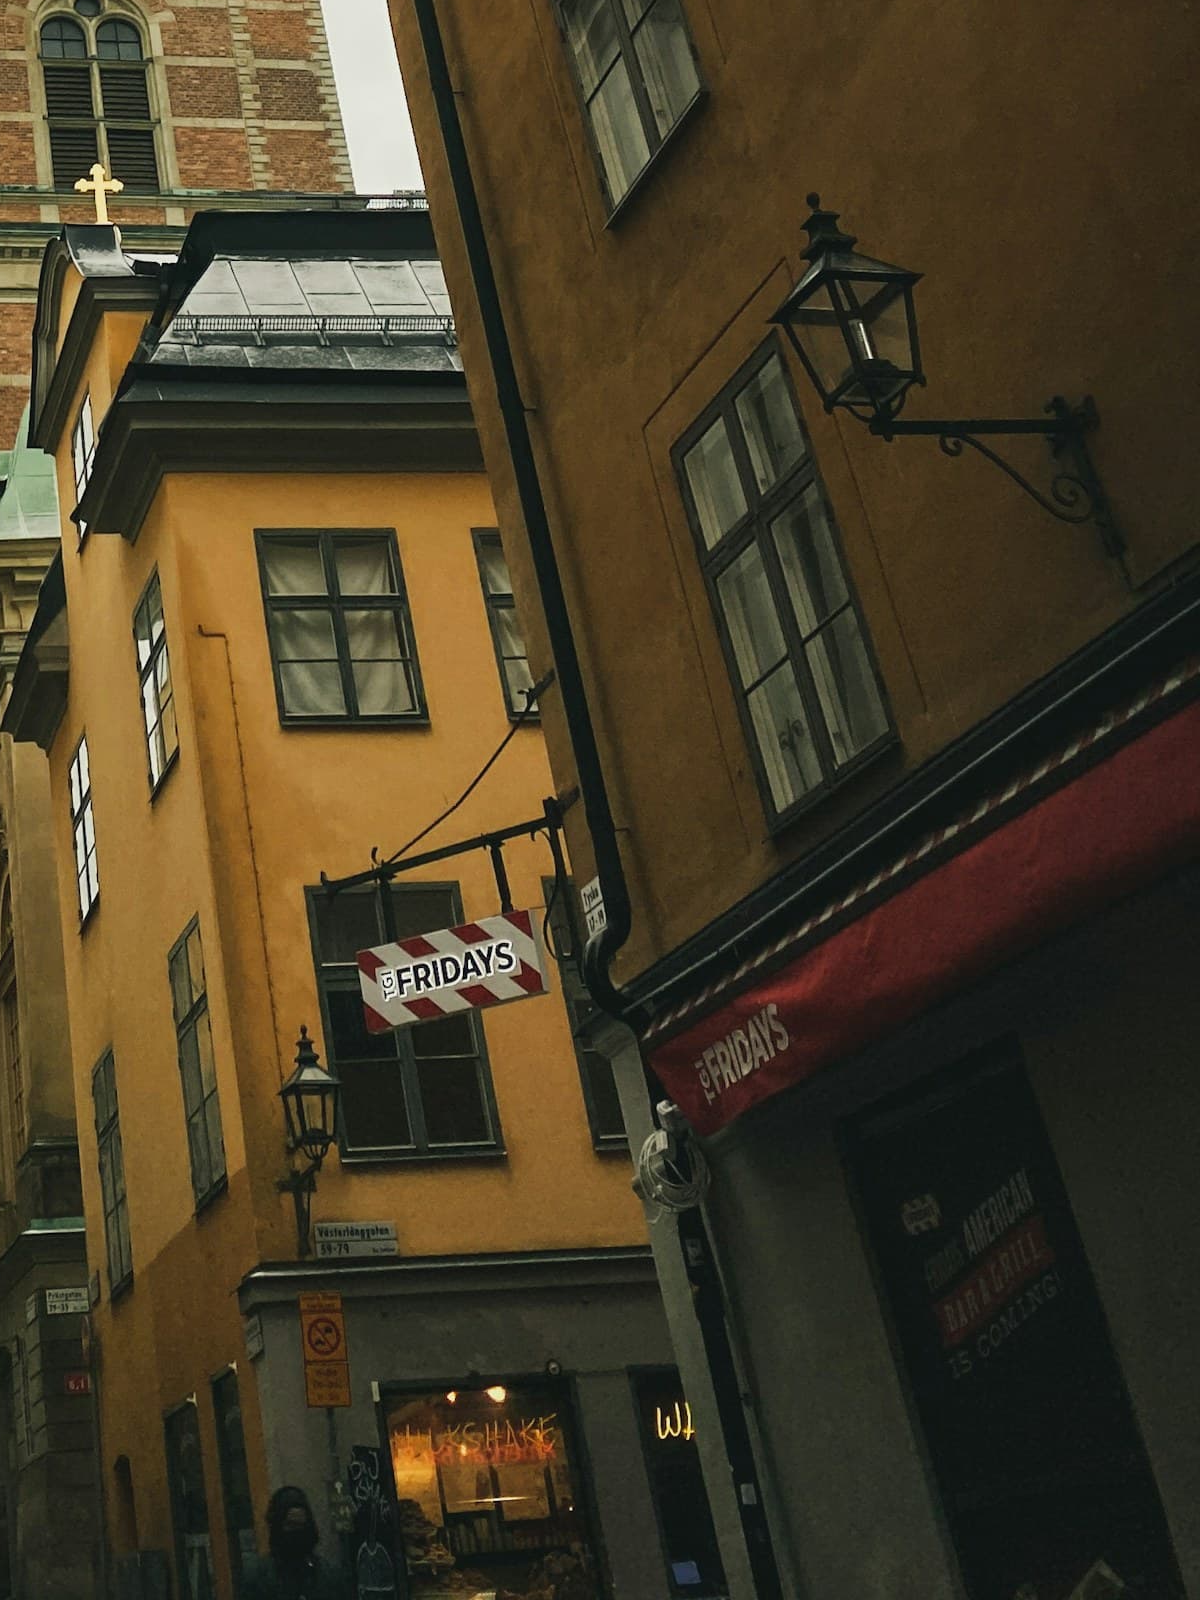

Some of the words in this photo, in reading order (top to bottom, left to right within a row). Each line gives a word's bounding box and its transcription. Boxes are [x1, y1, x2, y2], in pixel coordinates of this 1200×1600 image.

[381, 971, 396, 1001] TGI
[395, 941, 515, 997] FRIDAYS
[702, 1002, 789, 1095] FRIDAYS
[694, 1060, 716, 1106] TGI
[317, 1225, 390, 1238] Västerlånggatan
[962, 1167, 1035, 1259] AMERICAN
[943, 1287, 980, 1333] BAR
[990, 1230, 1041, 1294] GRILL
[947, 1350, 972, 1380] IS
